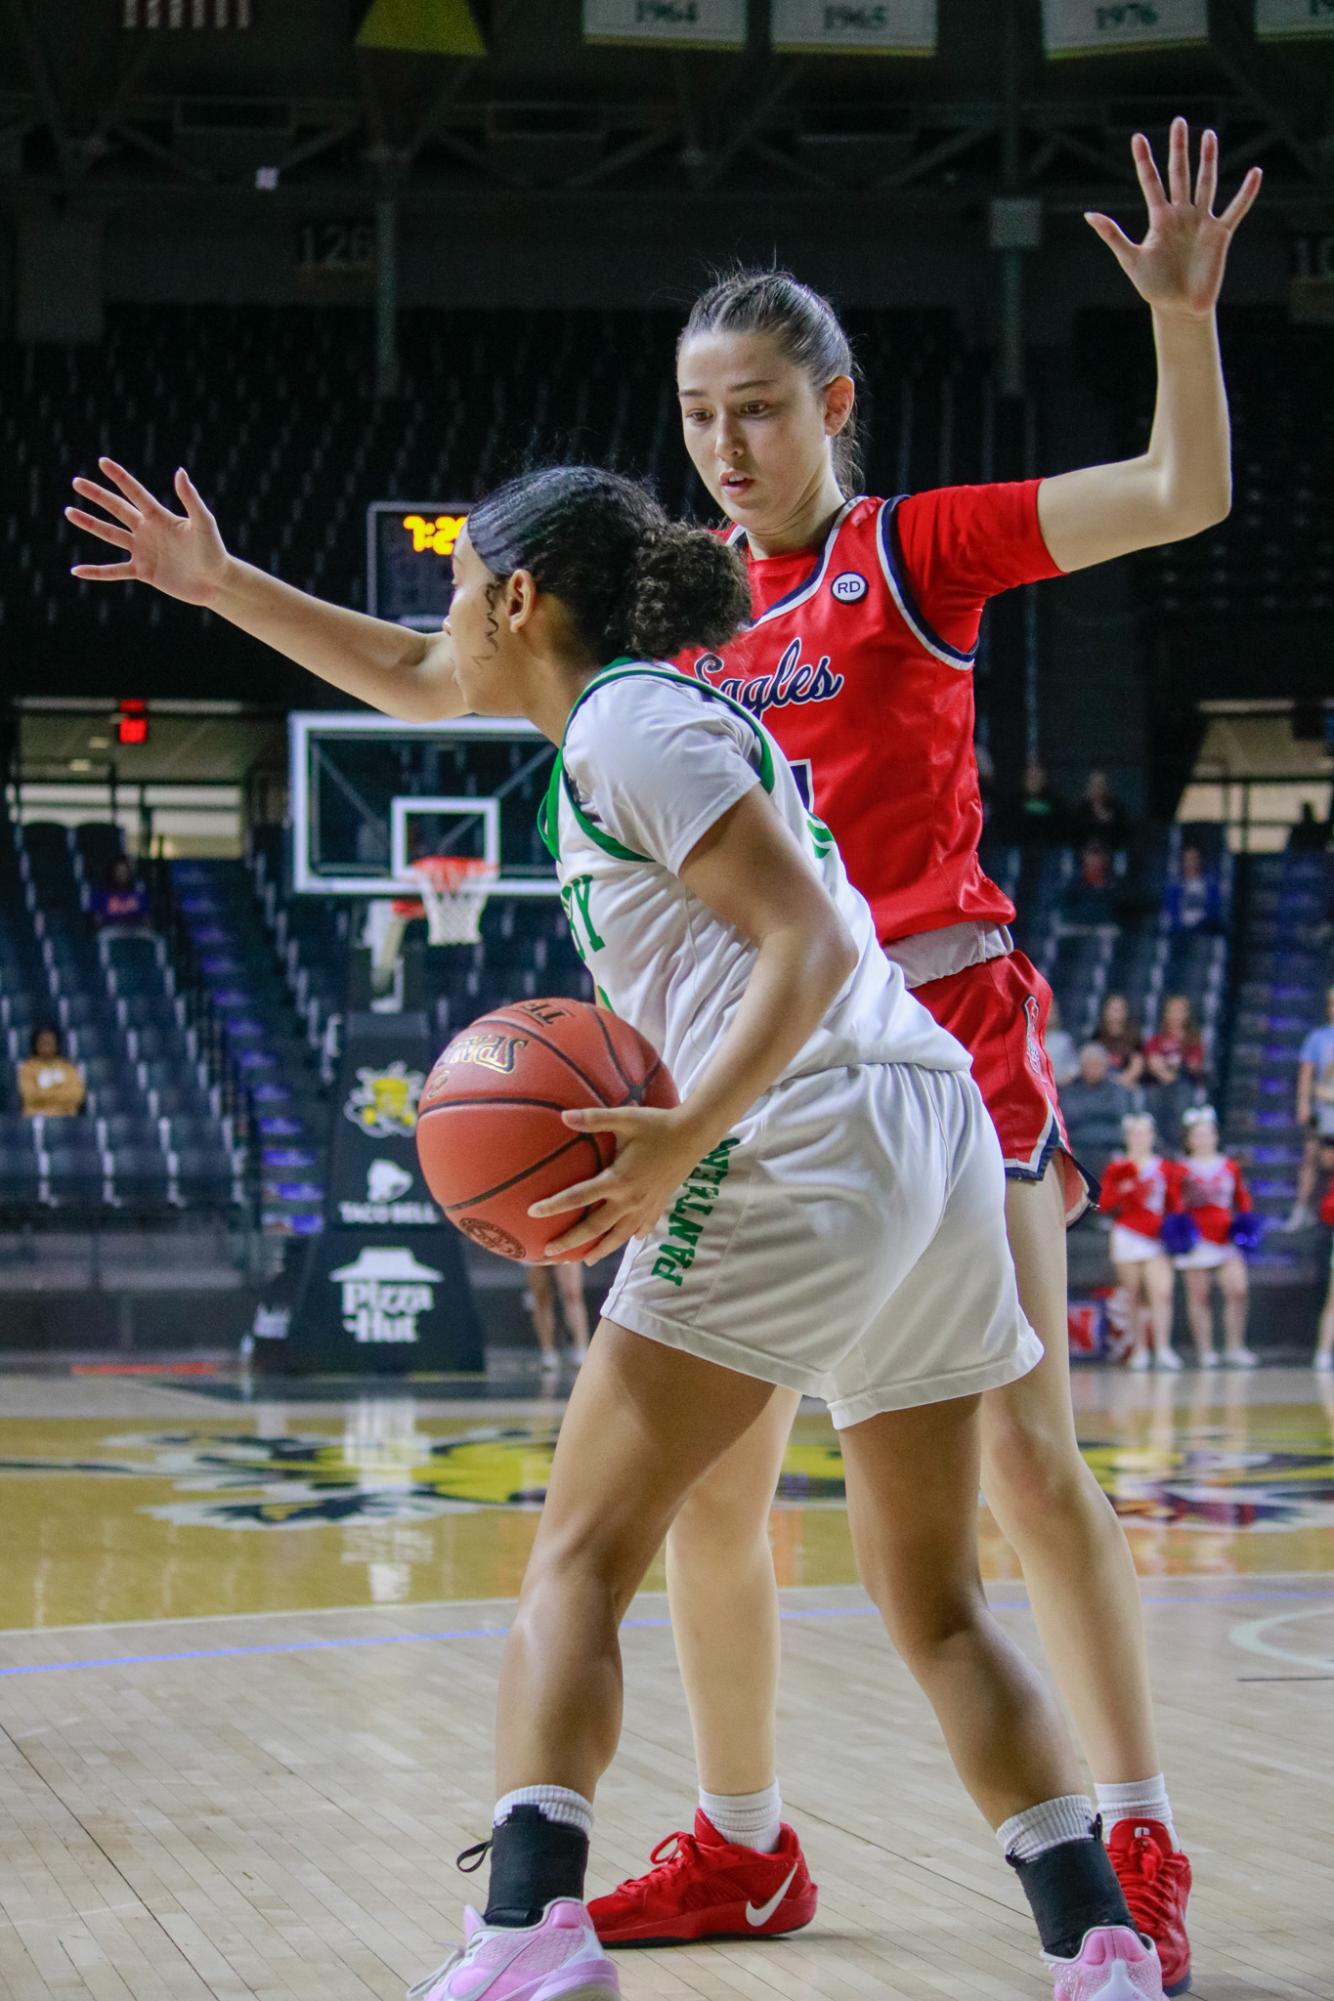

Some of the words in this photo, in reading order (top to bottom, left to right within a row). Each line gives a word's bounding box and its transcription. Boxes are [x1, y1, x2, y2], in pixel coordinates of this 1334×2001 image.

[823, 5, 888, 30] 1965
[1096, 3, 1158, 30] 1976
[837, 581, 861, 594] RD
[337, 1201, 388, 1224] TACO
[391, 1201, 439, 1224] BELL
[342, 1281, 435, 1314] Pizza
[343, 1308, 418, 1342] Hut
